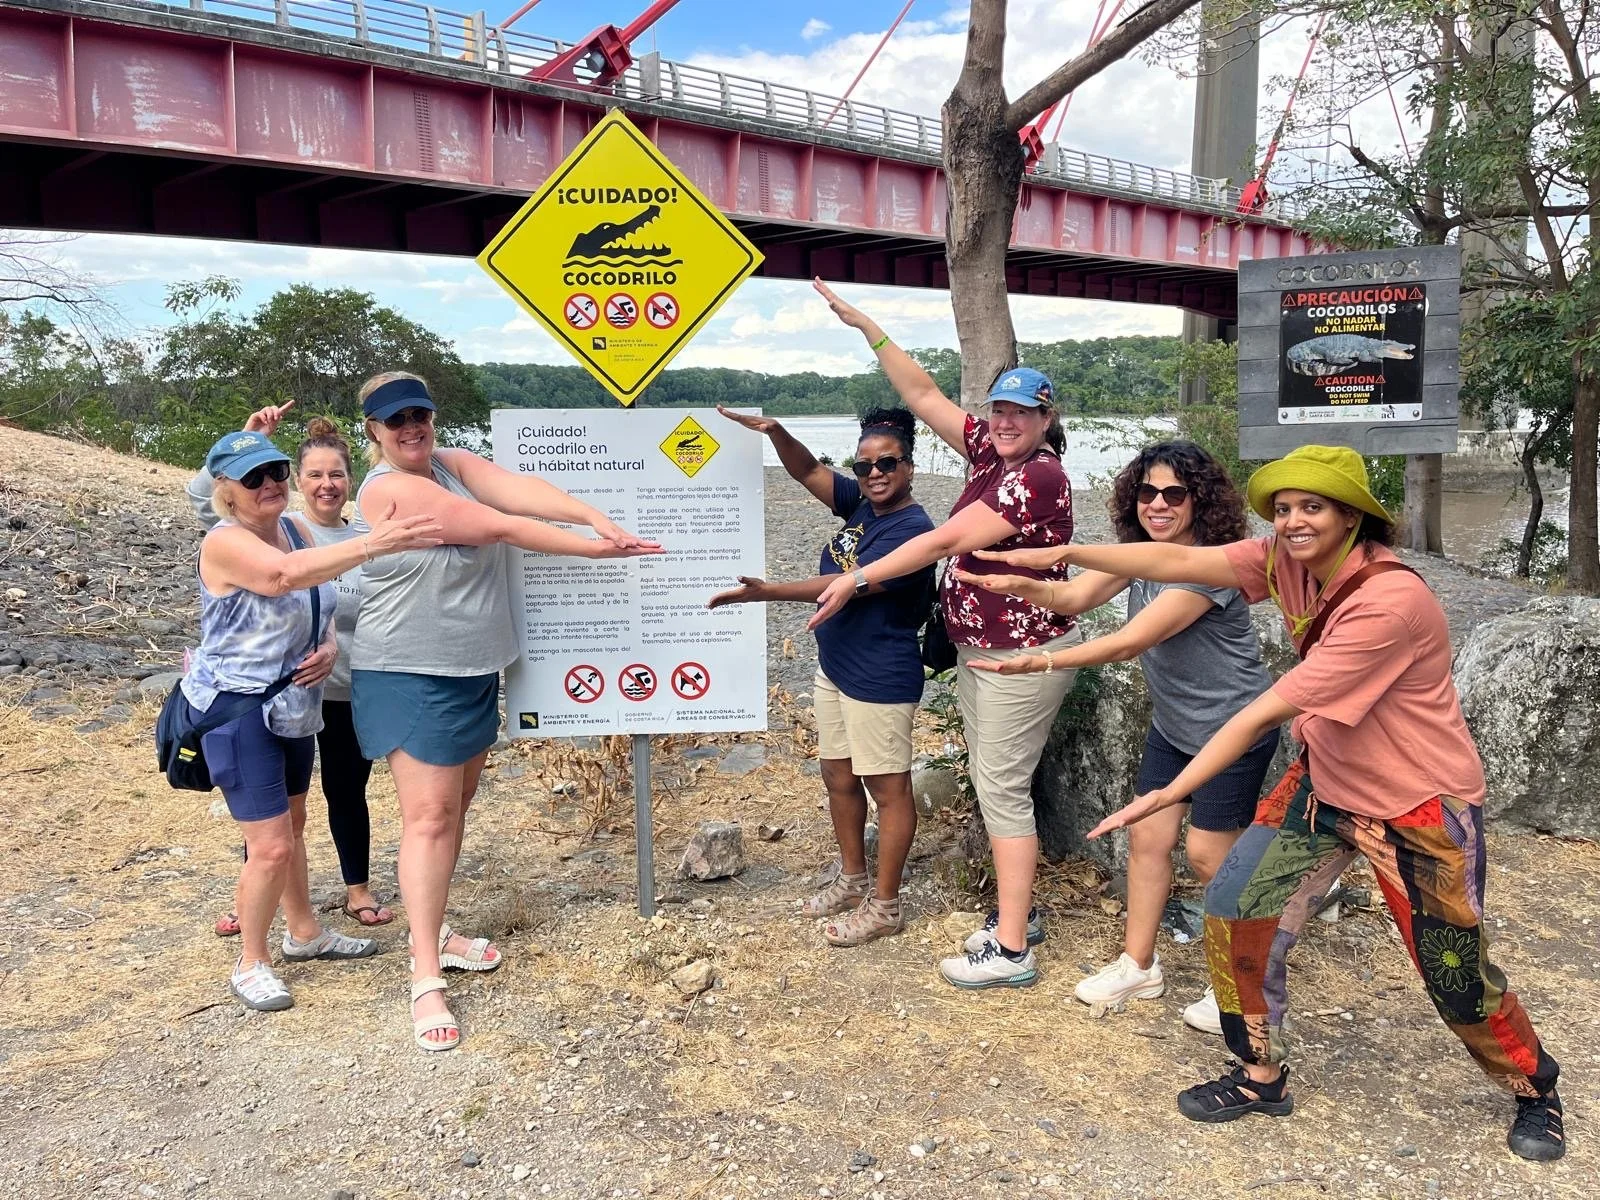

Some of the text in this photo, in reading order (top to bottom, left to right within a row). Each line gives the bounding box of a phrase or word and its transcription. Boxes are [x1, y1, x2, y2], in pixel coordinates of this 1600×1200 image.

[558, 188, 677, 204] ¡CUIDADO!
[1276, 260, 1421, 283] COCODRILOS
[563, 272, 677, 286] COCODRILO
[1297, 286, 1407, 306] PRECAUCIÓN
[1308, 304, 1396, 318] COCODRILOS
[1332, 324, 1385, 333] ALIMENTAR
[1325, 376, 1375, 385] CAUTION
[517, 426, 587, 439] ¡Cuidado!
[517, 442, 607, 455] Cocodrilo en
[519, 460, 644, 472] su hábitat natural
